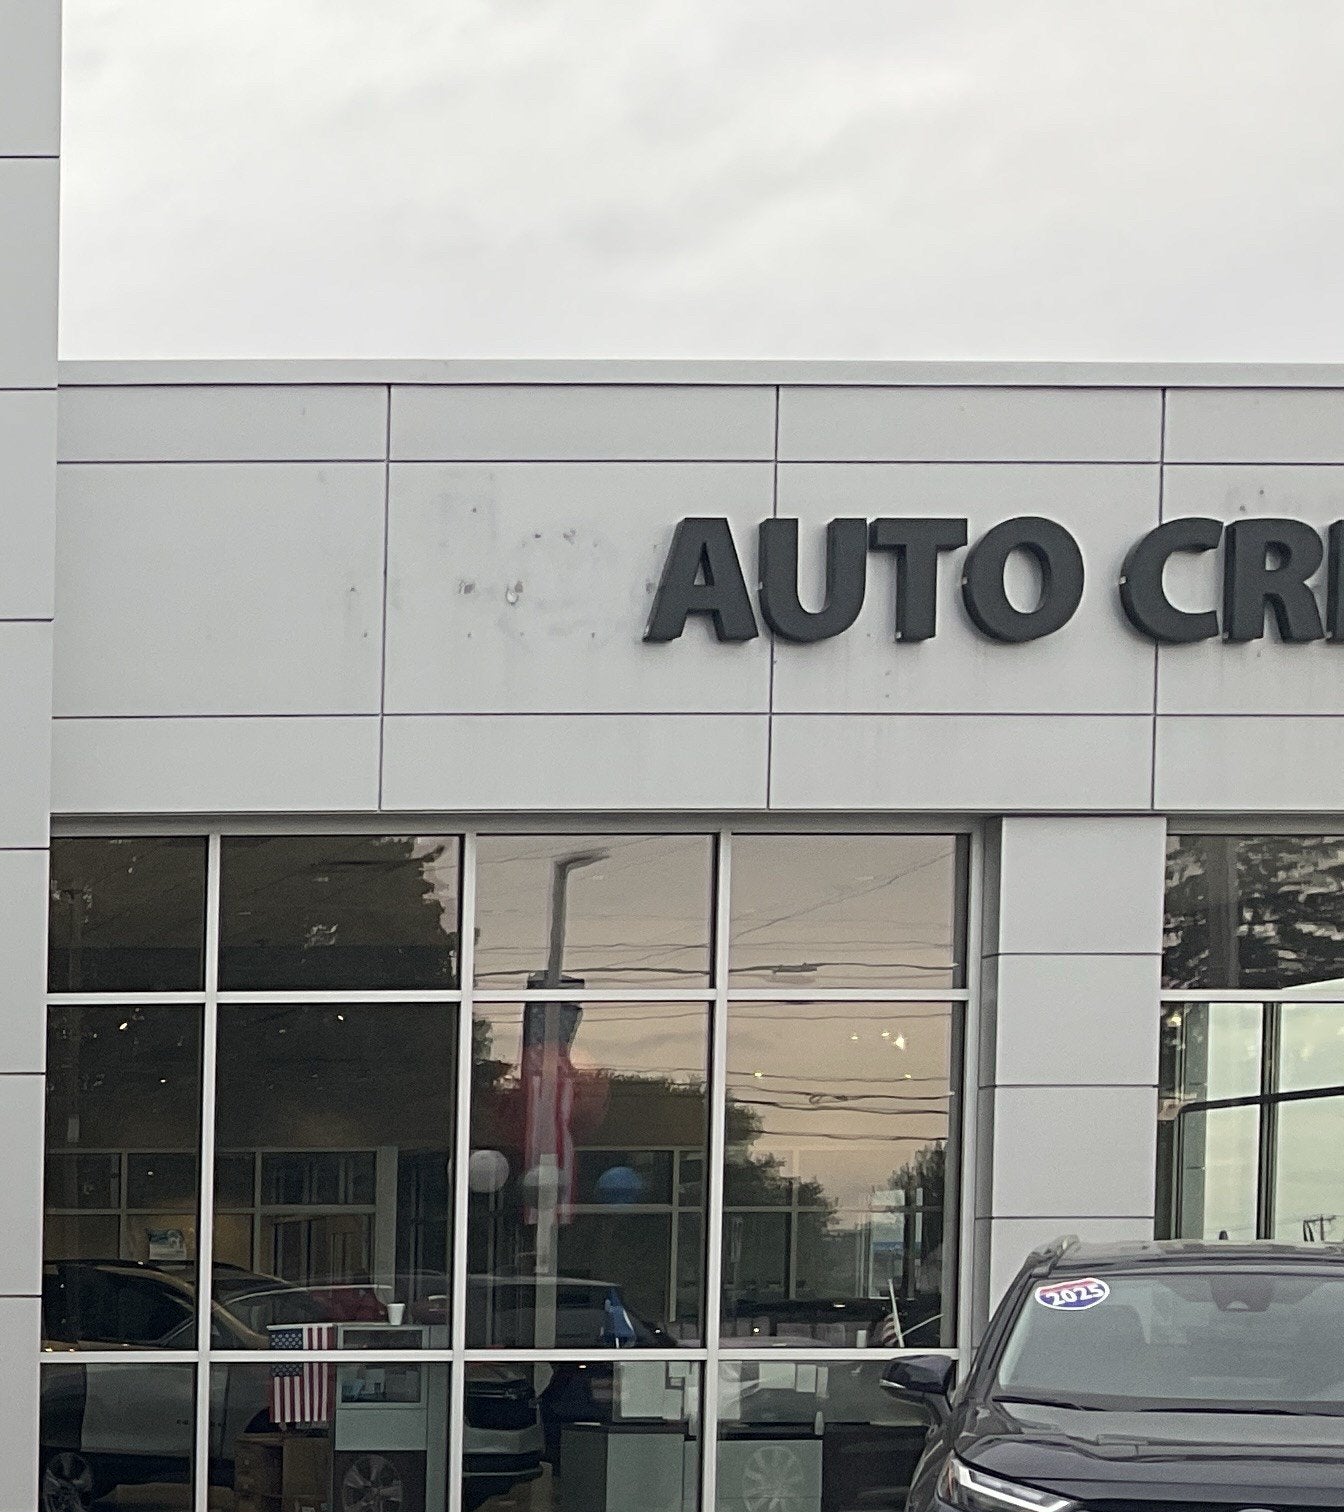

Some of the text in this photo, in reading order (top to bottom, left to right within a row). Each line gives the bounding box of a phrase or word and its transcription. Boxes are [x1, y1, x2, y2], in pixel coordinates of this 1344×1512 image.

[643, 516, 1344, 647] AUTO CR
[1045, 1283, 1105, 1306] 2025
